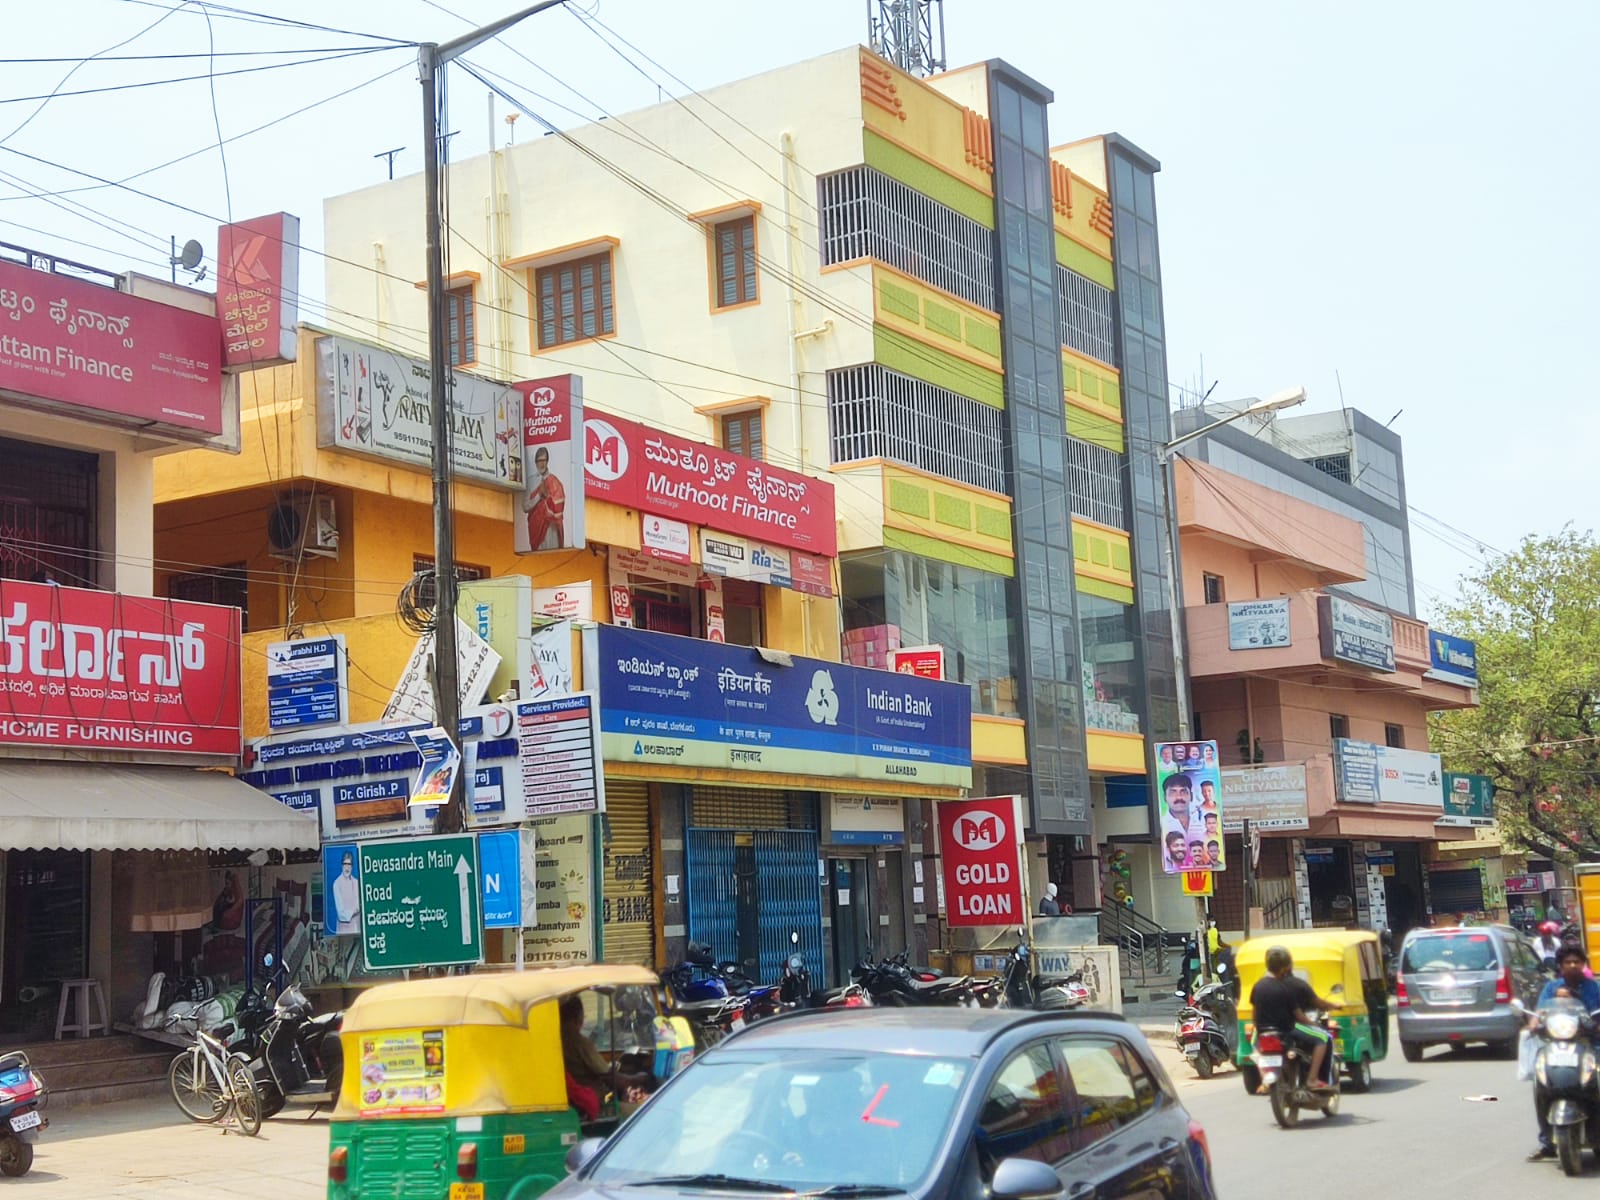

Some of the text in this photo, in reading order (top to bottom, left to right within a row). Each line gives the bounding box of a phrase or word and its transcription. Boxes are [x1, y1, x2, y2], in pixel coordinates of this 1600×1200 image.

[228, 337, 265, 353] ಸಾಲ
[0, 335, 51, 364] ttam
[56, 345, 133, 382] Finance
[525, 414, 562, 427] Muthoot
[534, 407, 551, 417] The
[528, 425, 557, 436] Group
[646, 472, 729, 512] Muthoot
[732, 495, 797, 529] Finance
[752, 549, 771, 568] Ria
[613, 590, 629, 608] 89
[617, 657, 664, 677] ಇಂಡಿಯನ್
[717, 666, 753, 693] इंडियन
[754, 672, 772, 695] बैंक
[521, 699, 585, 714] Services Provided:
[867, 688, 932, 717] Indian Bank
[0, 720, 193, 745] HOME FURNISHING
[885, 764, 917, 776] ALLAHABAD
[280, 792, 312, 806] Tanuja
[340, 788, 354, 801] Dr.
[356, 784, 385, 799] Girish
[537, 804, 552, 814] Types
[364, 850, 453, 873] Devasandra Main
[956, 863, 1010, 885] GOLD
[366, 882, 392, 902] Road
[958, 894, 1012, 916] LOAN
[367, 908, 414, 928] ದೇವಸಂದ್ರ
[369, 932, 386, 954] ರಸ್ತೆ
